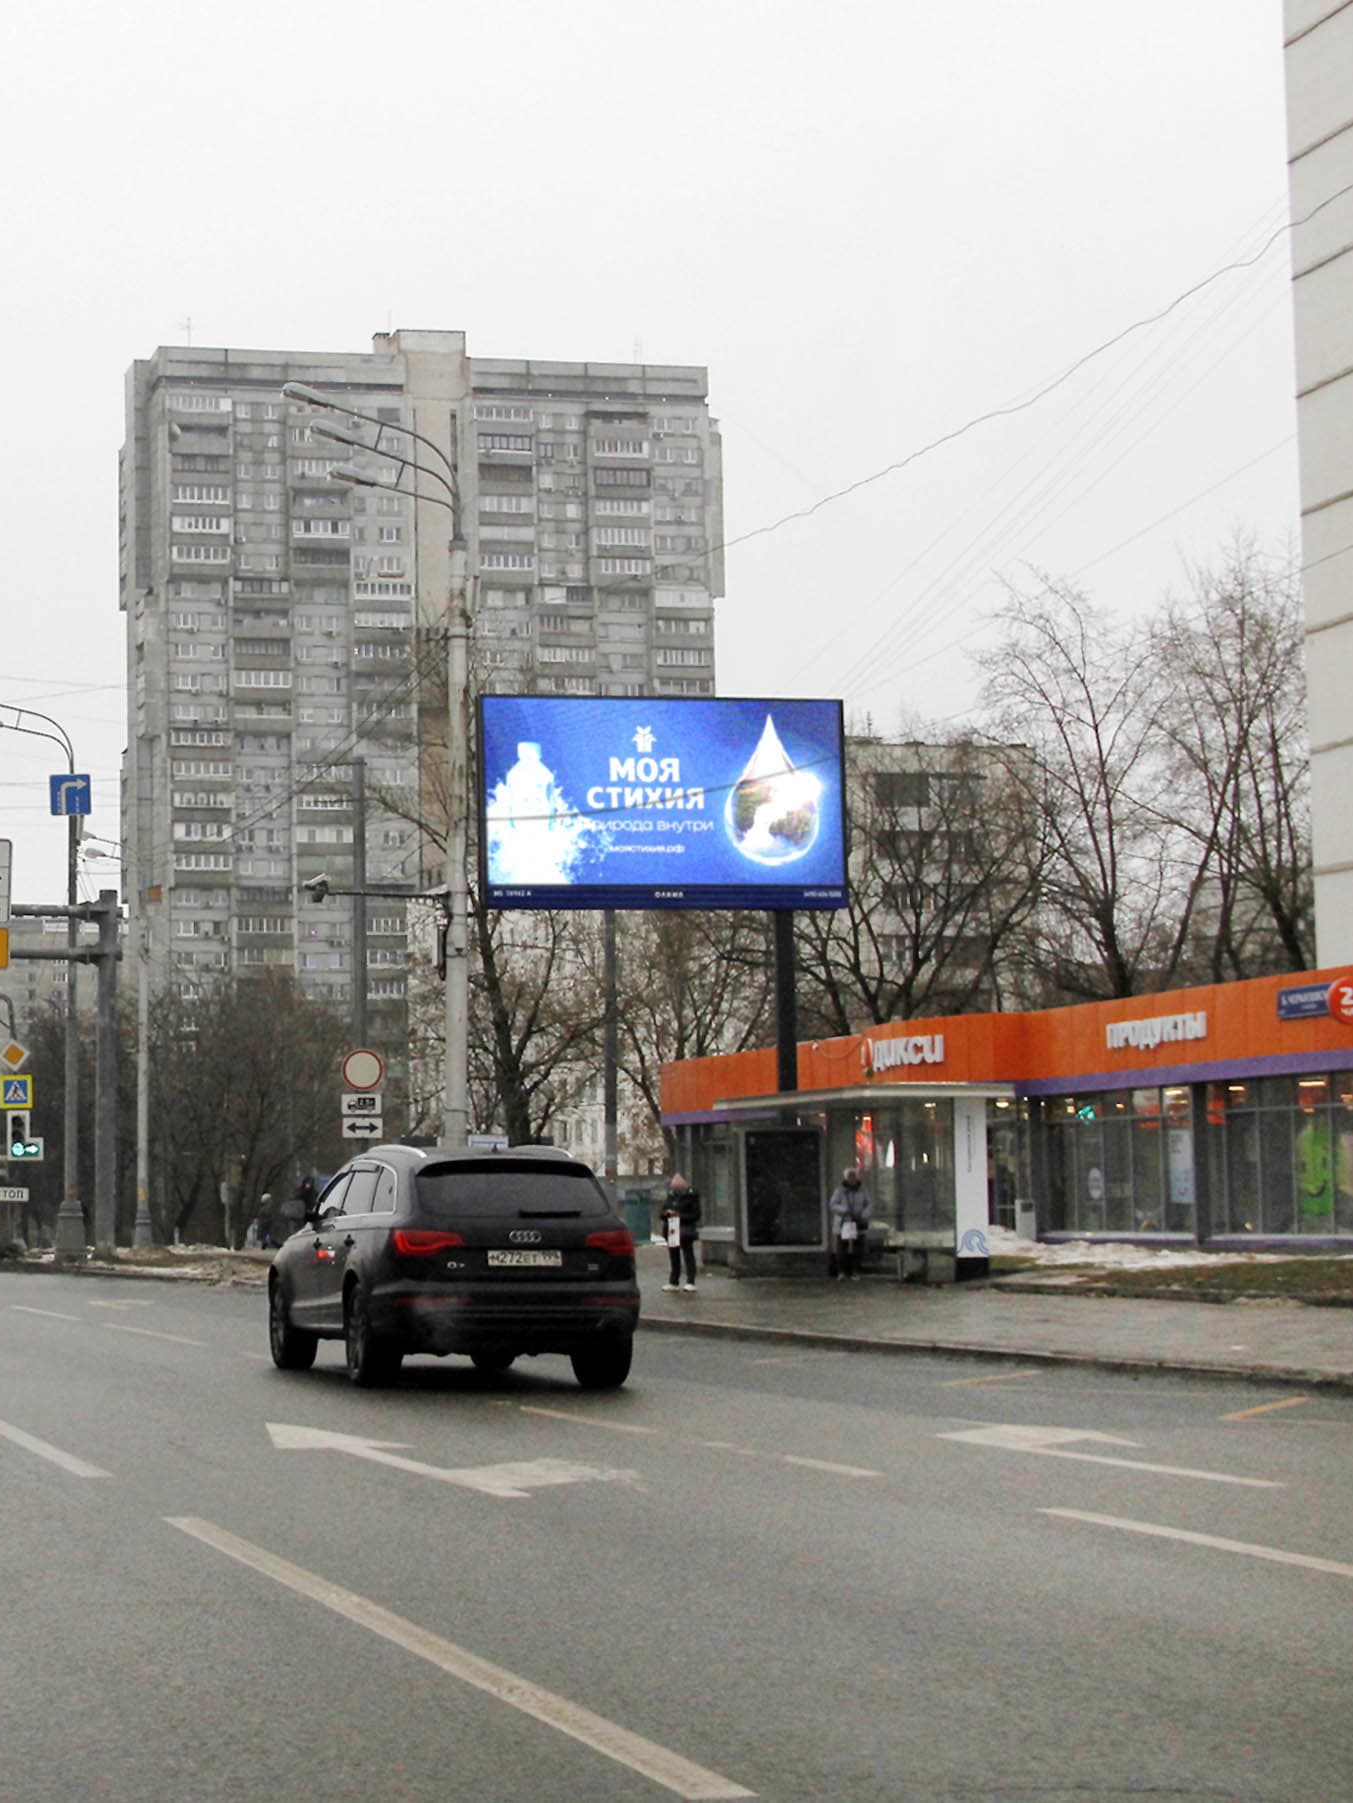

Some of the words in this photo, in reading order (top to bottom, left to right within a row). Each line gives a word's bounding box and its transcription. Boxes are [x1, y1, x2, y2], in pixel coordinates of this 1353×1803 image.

[609, 757, 680, 783] МОЯ
[586, 786, 705, 809] СТИХИЯ
[656, 819, 715, 834] внутри
[1105, 1010, 1207, 1051] ПРОДУКТЫ
